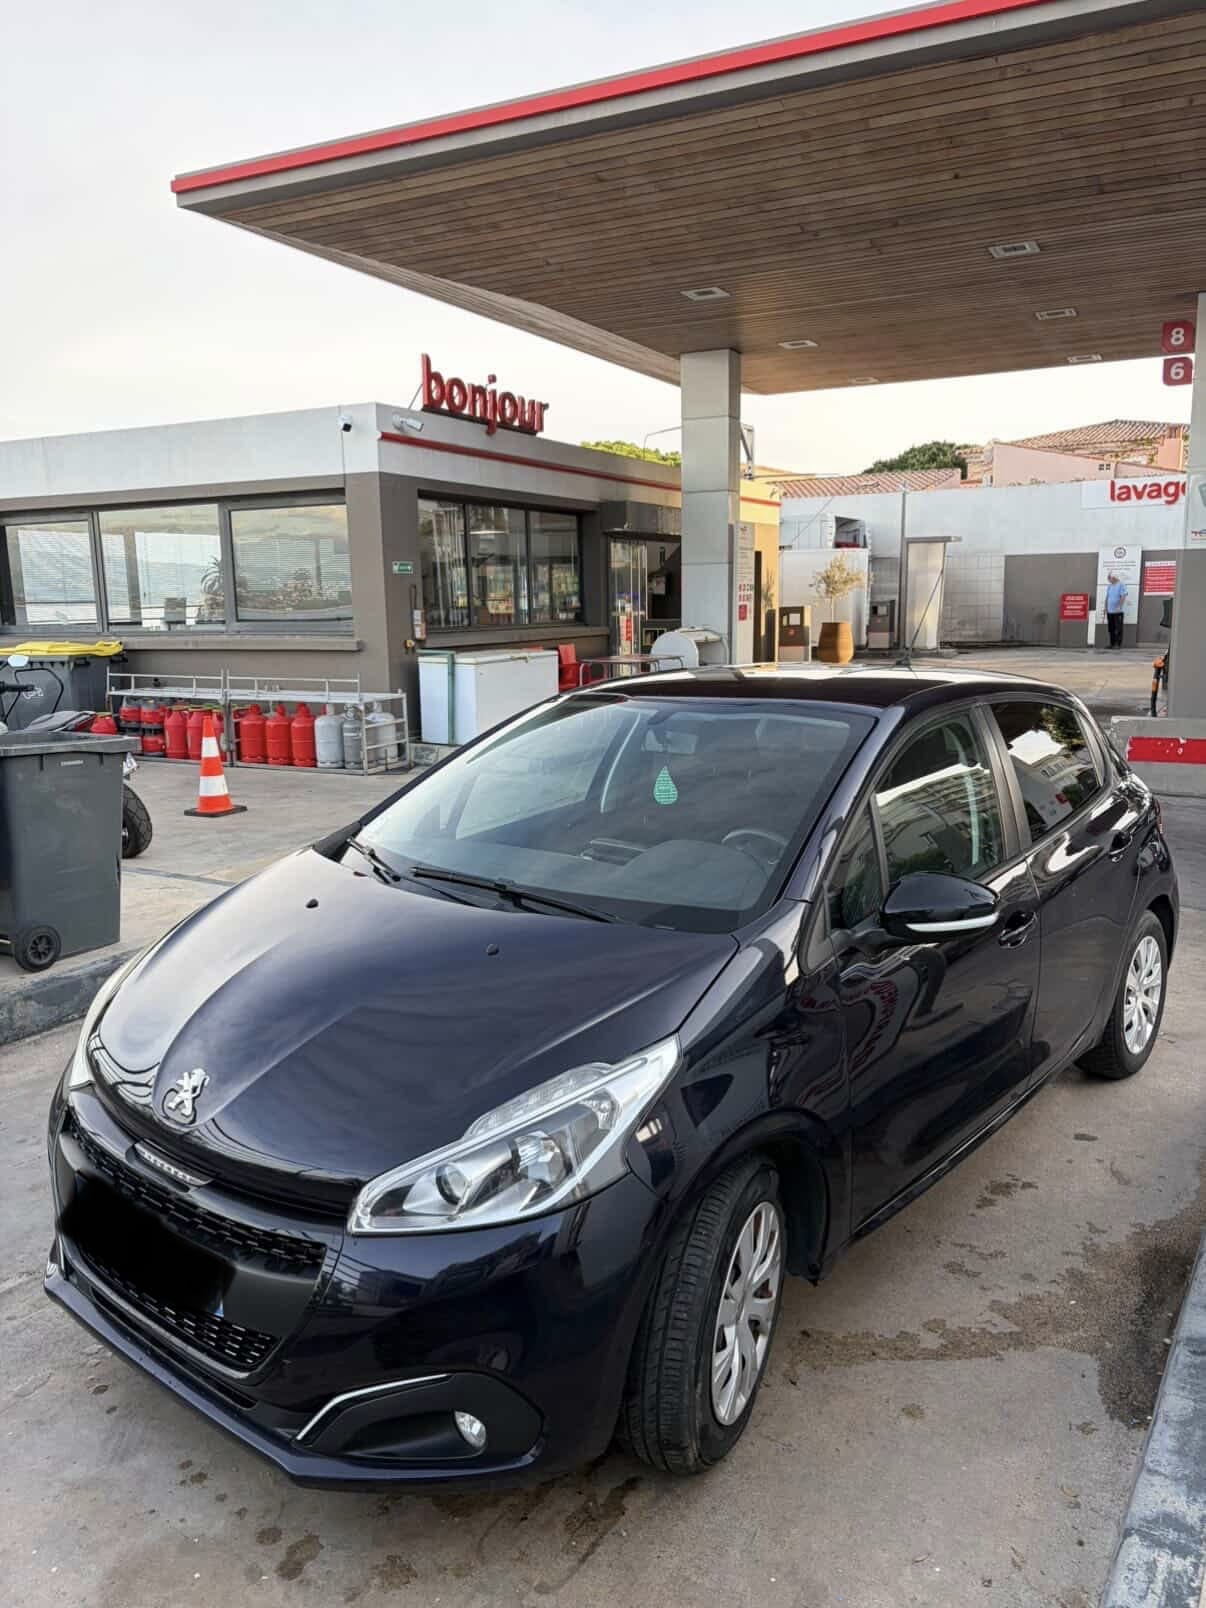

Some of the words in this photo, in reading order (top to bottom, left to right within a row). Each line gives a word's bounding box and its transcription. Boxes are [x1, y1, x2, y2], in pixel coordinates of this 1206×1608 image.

[1170, 327, 1185, 345] 8
[1170, 362, 1185, 380] 6
[421, 353, 549, 436] bonjour
